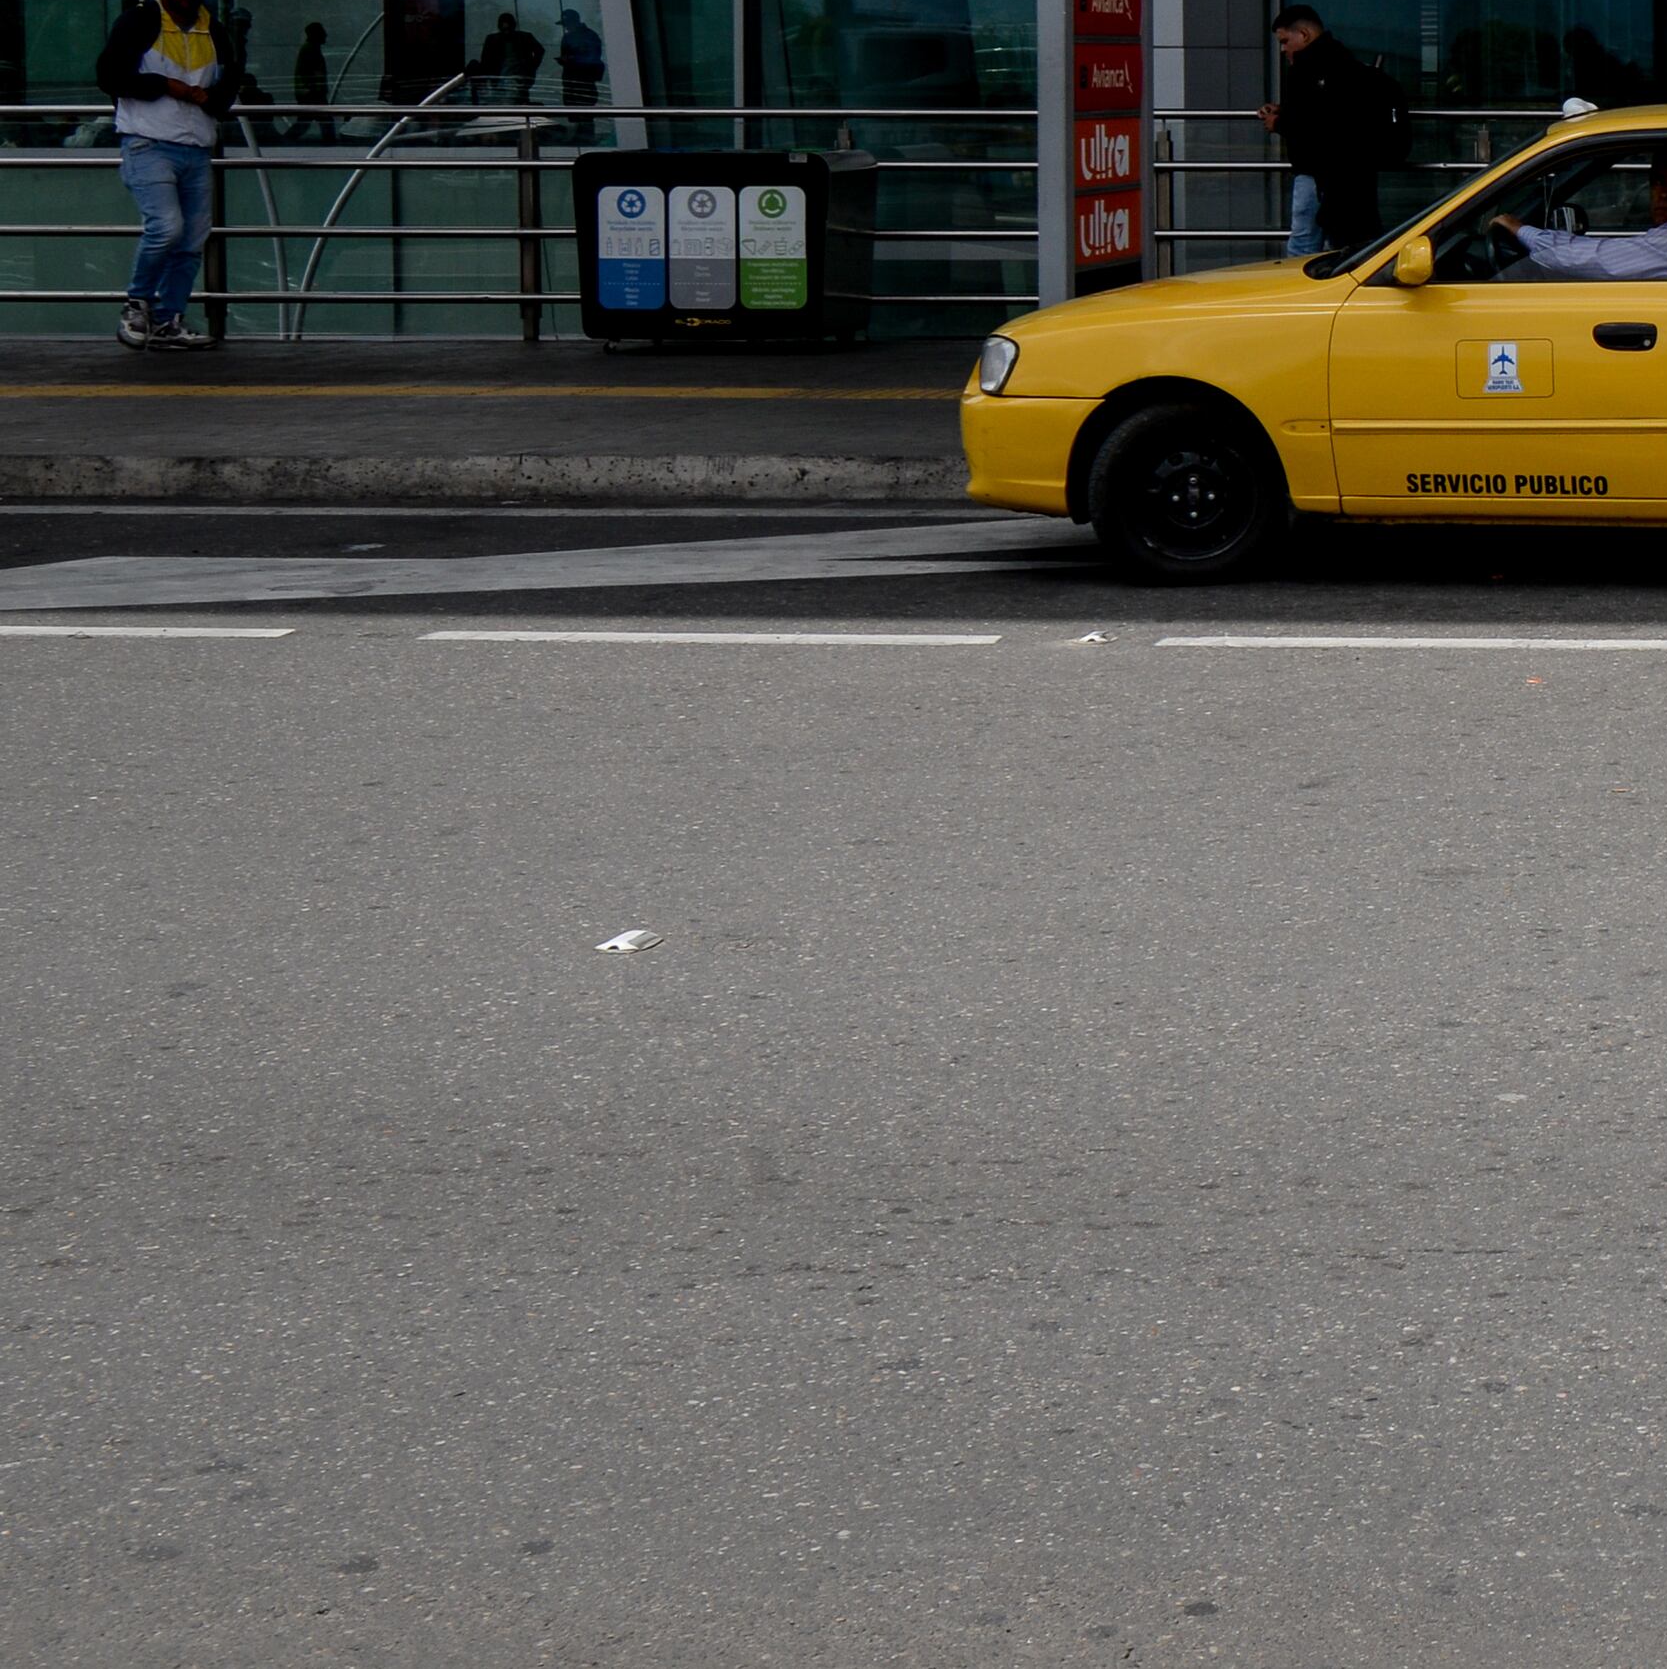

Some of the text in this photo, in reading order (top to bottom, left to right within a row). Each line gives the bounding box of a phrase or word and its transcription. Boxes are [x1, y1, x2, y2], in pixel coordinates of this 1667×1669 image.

[1091, 63, 1124, 89] Avianca
[1406, 473, 1608, 495] SERVICIO PUBLICO
